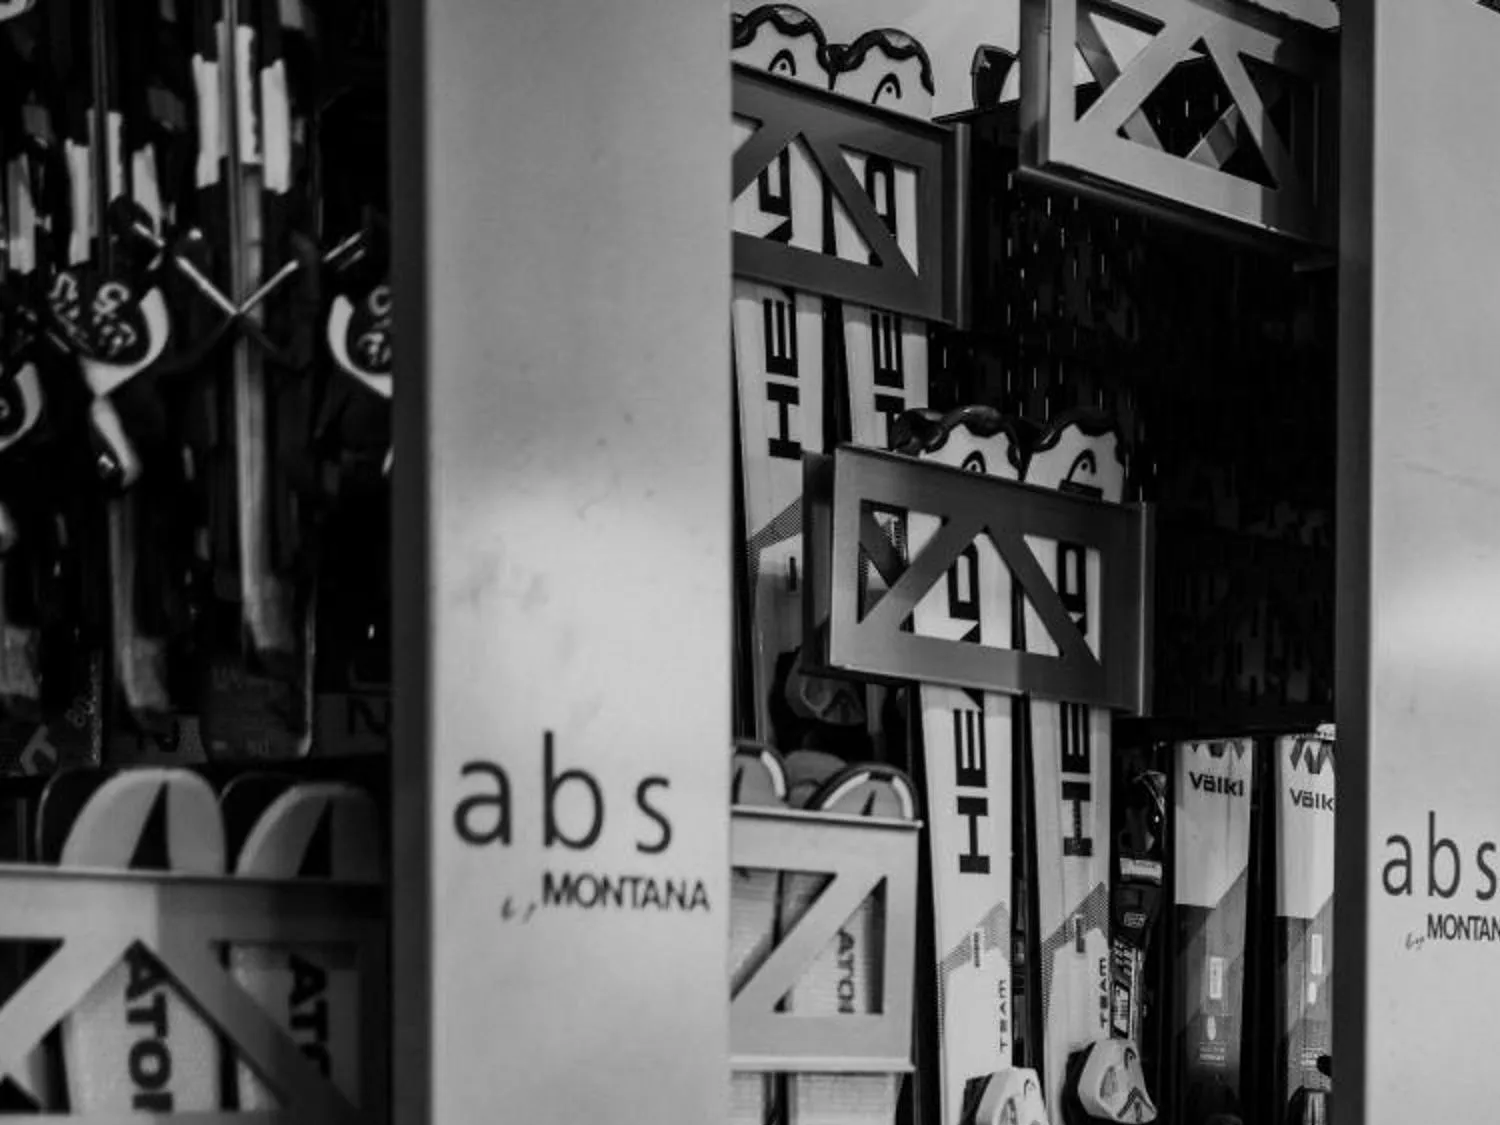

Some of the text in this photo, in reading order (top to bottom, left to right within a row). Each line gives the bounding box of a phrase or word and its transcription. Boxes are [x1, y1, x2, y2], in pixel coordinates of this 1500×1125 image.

[757, 147, 802, 461] HED
[454, 730, 672, 854] abs
[1189, 771, 1245, 797] Völkl
[1290, 787, 1334, 812] Völk
[1382, 810, 1497, 901] abs
[542, 870, 710, 912] MONTANA
